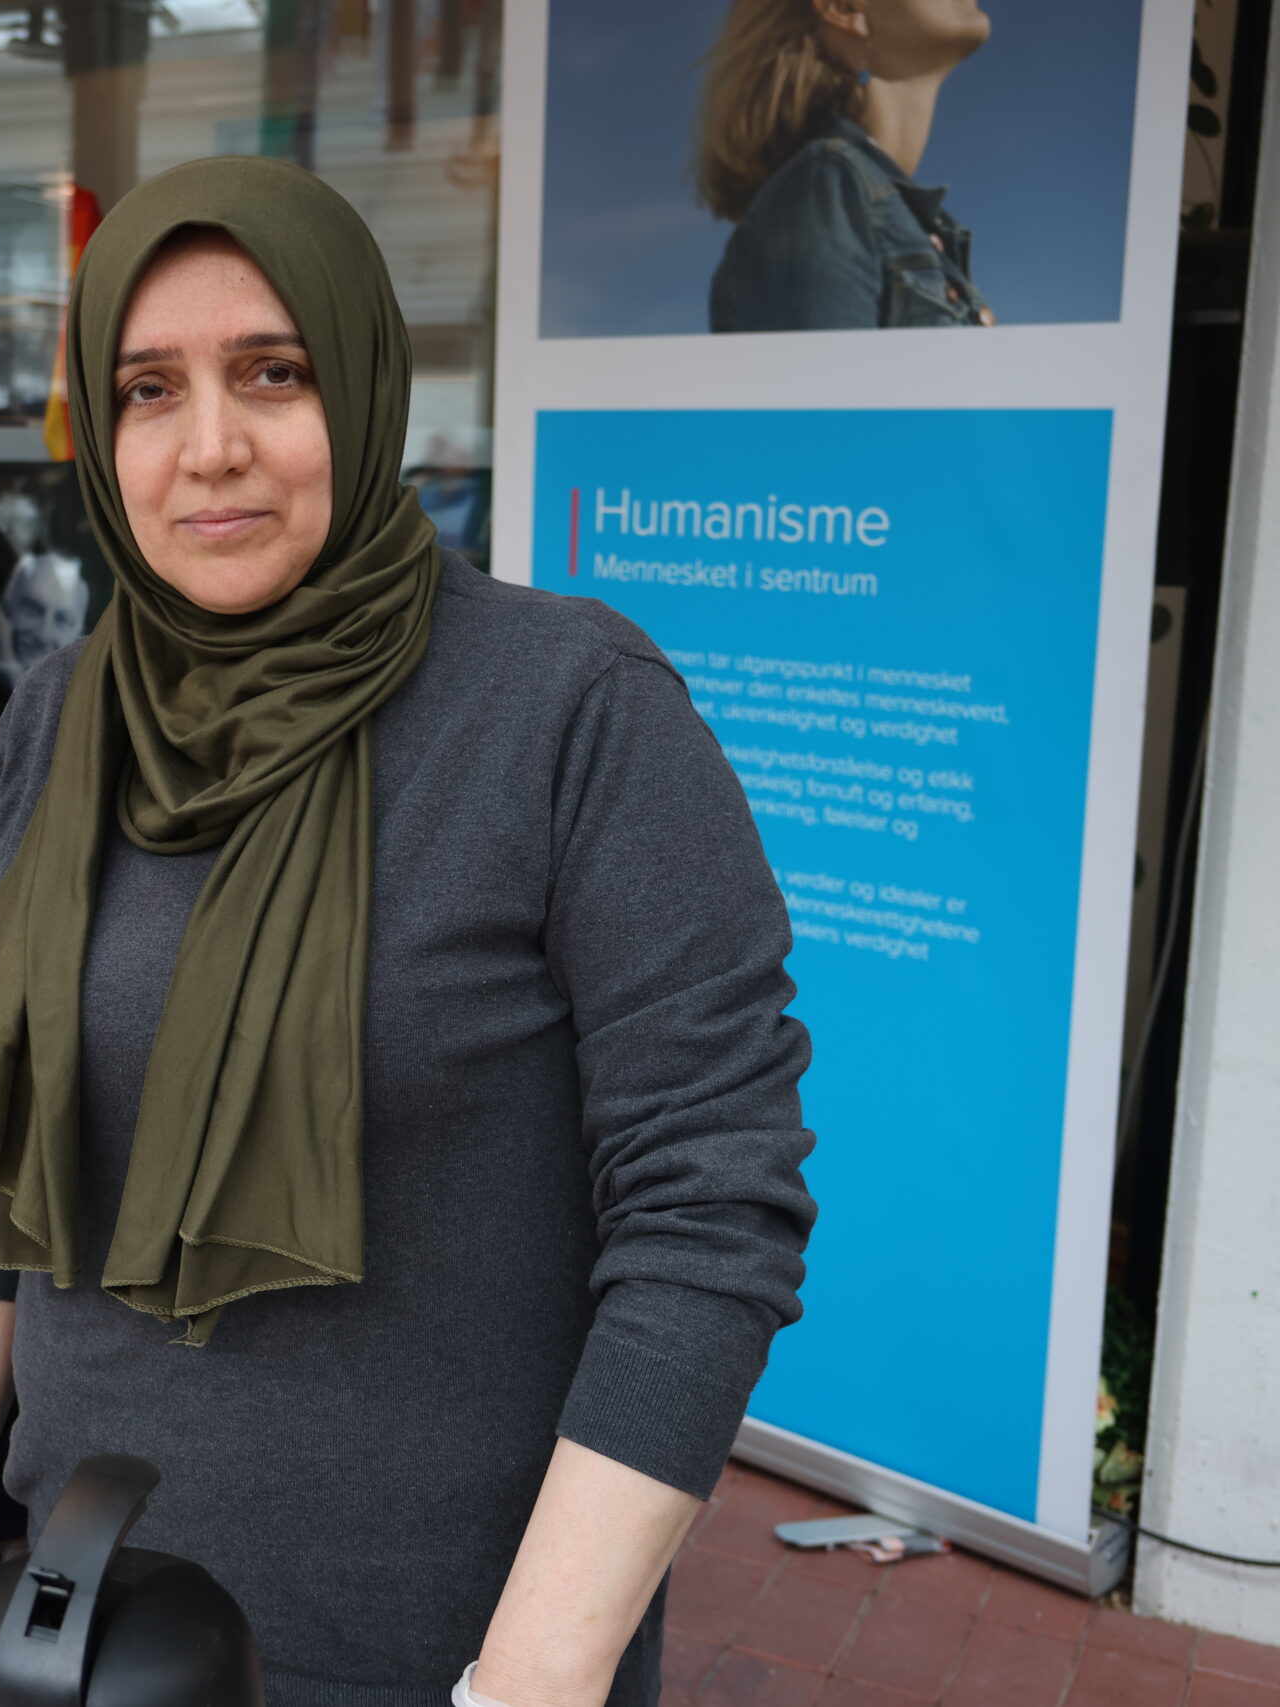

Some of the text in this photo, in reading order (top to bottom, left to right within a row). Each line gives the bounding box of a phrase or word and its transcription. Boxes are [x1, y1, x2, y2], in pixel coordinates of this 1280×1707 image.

[593, 486, 890, 547] Humanisme
[593, 552, 878, 597] Mennesket i sentrum
[735, 653, 854, 681] utgangspunkt
[868, 667, 972, 693] mennesket
[747, 680, 783, 699] den
[786, 683, 861, 708] enkeltes
[840, 718, 866, 739] og
[870, 718, 958, 746] verdighet
[896, 766, 923, 789] og
[927, 769, 975, 791] etikk
[866, 789, 893, 812] og
[891, 817, 918, 841] og
[847, 880, 875, 904] og
[843, 929, 930, 961] verdighet
